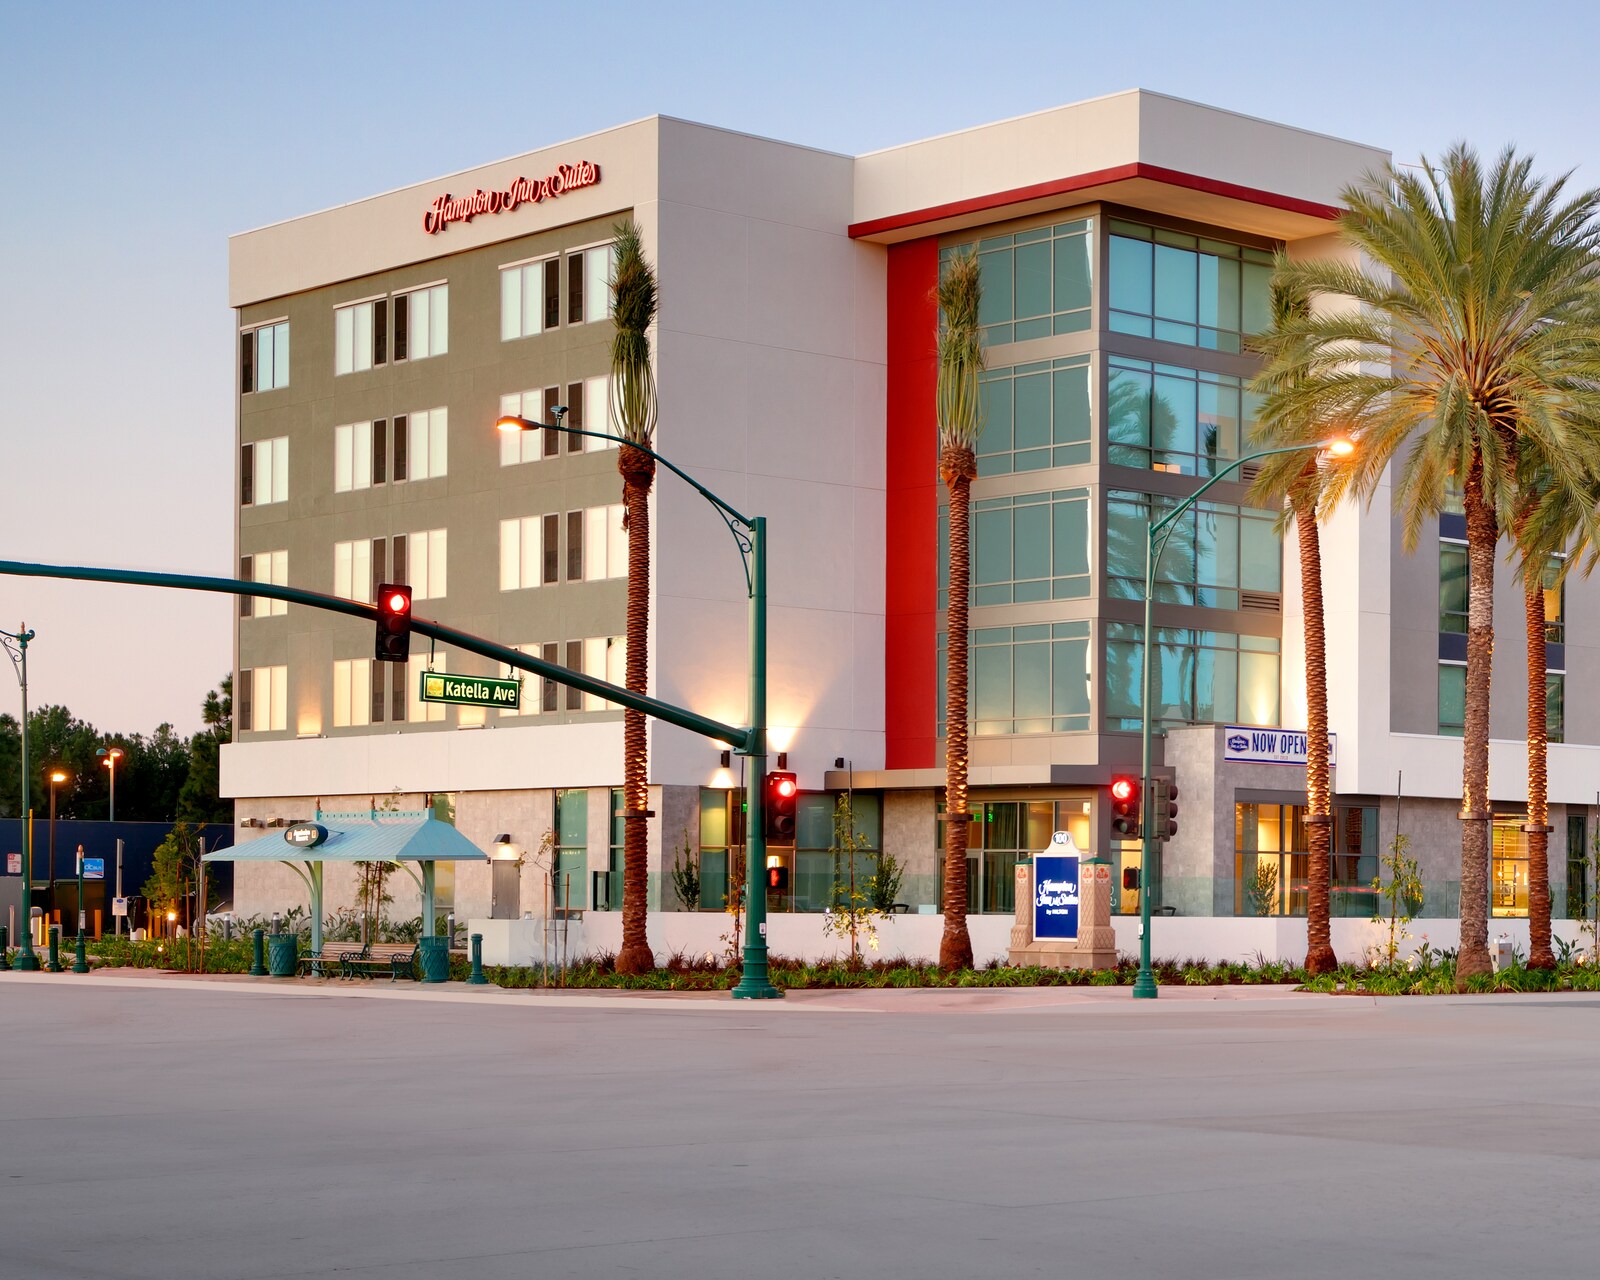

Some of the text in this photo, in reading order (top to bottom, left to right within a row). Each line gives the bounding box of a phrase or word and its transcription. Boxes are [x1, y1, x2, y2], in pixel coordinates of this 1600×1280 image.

[423, 160, 601, 235] Hampton Inn & Suites
[445, 681, 516, 701] Katella Ave
[1252, 732, 1277, 753] NOW
[1280, 734, 1307, 755] OPEN
[1055, 833, 1068, 843] 100
